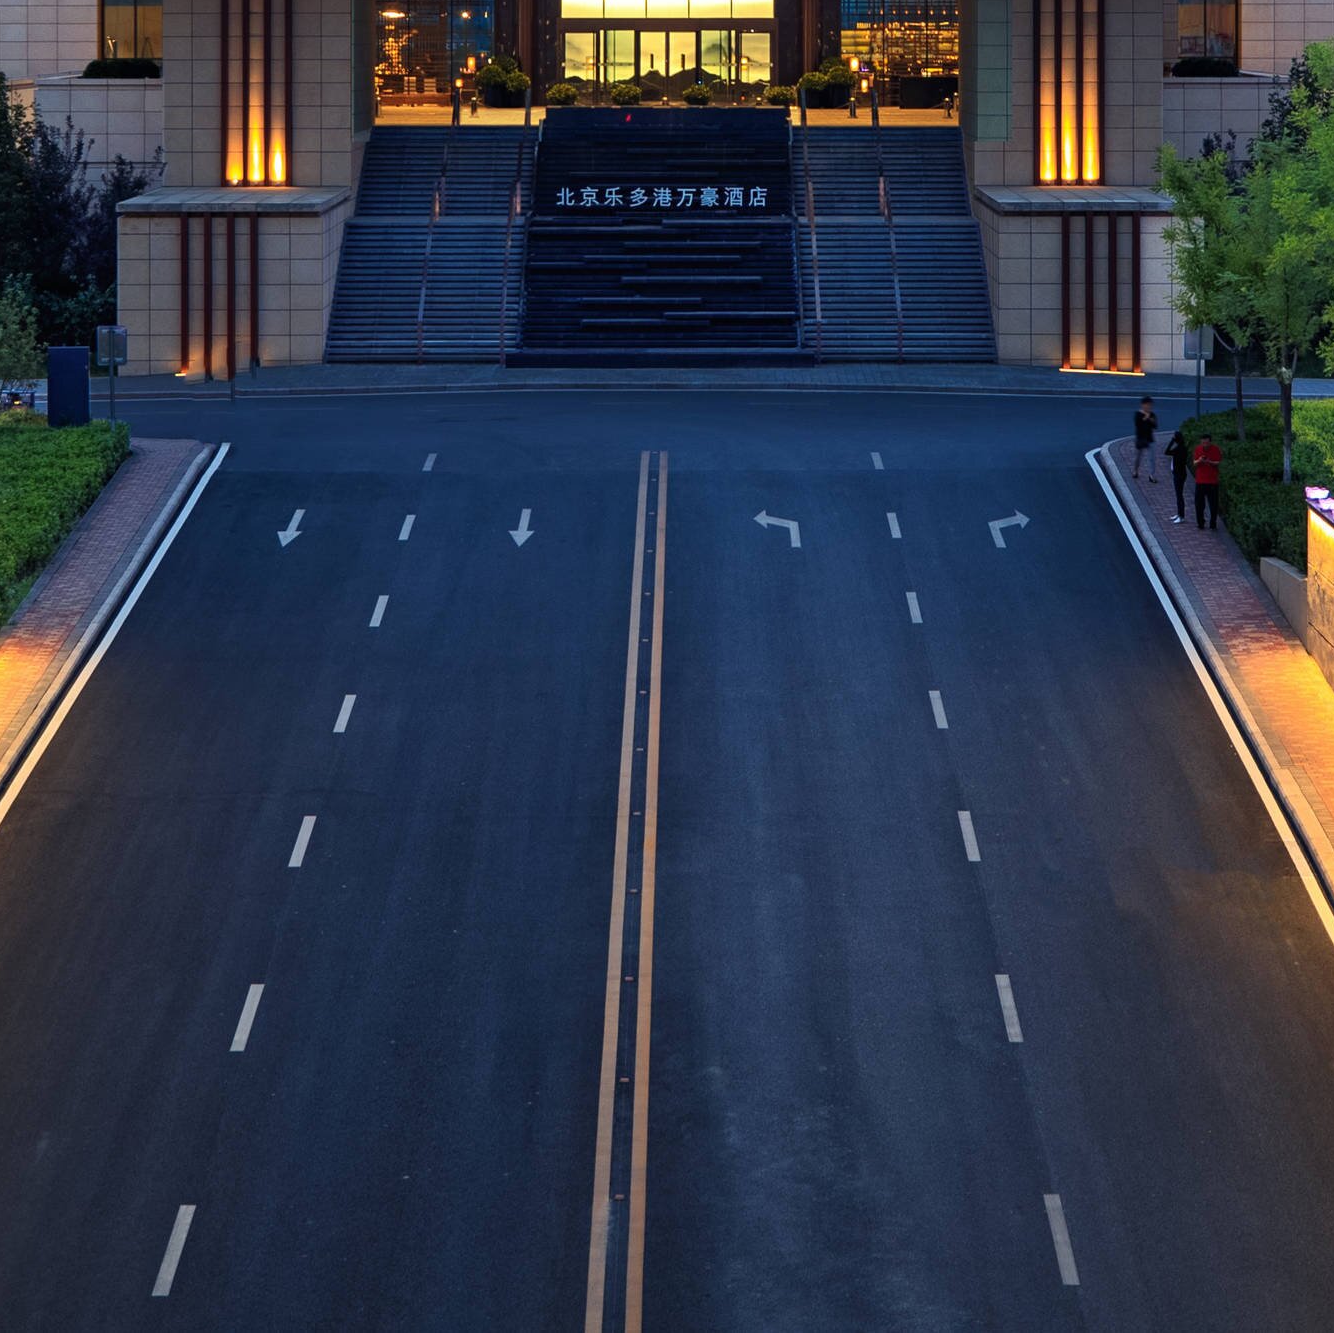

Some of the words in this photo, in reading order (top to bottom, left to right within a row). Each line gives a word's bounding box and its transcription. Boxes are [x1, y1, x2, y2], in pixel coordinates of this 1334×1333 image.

[556, 186, 768, 207] 北京乐多港万豪酒店
